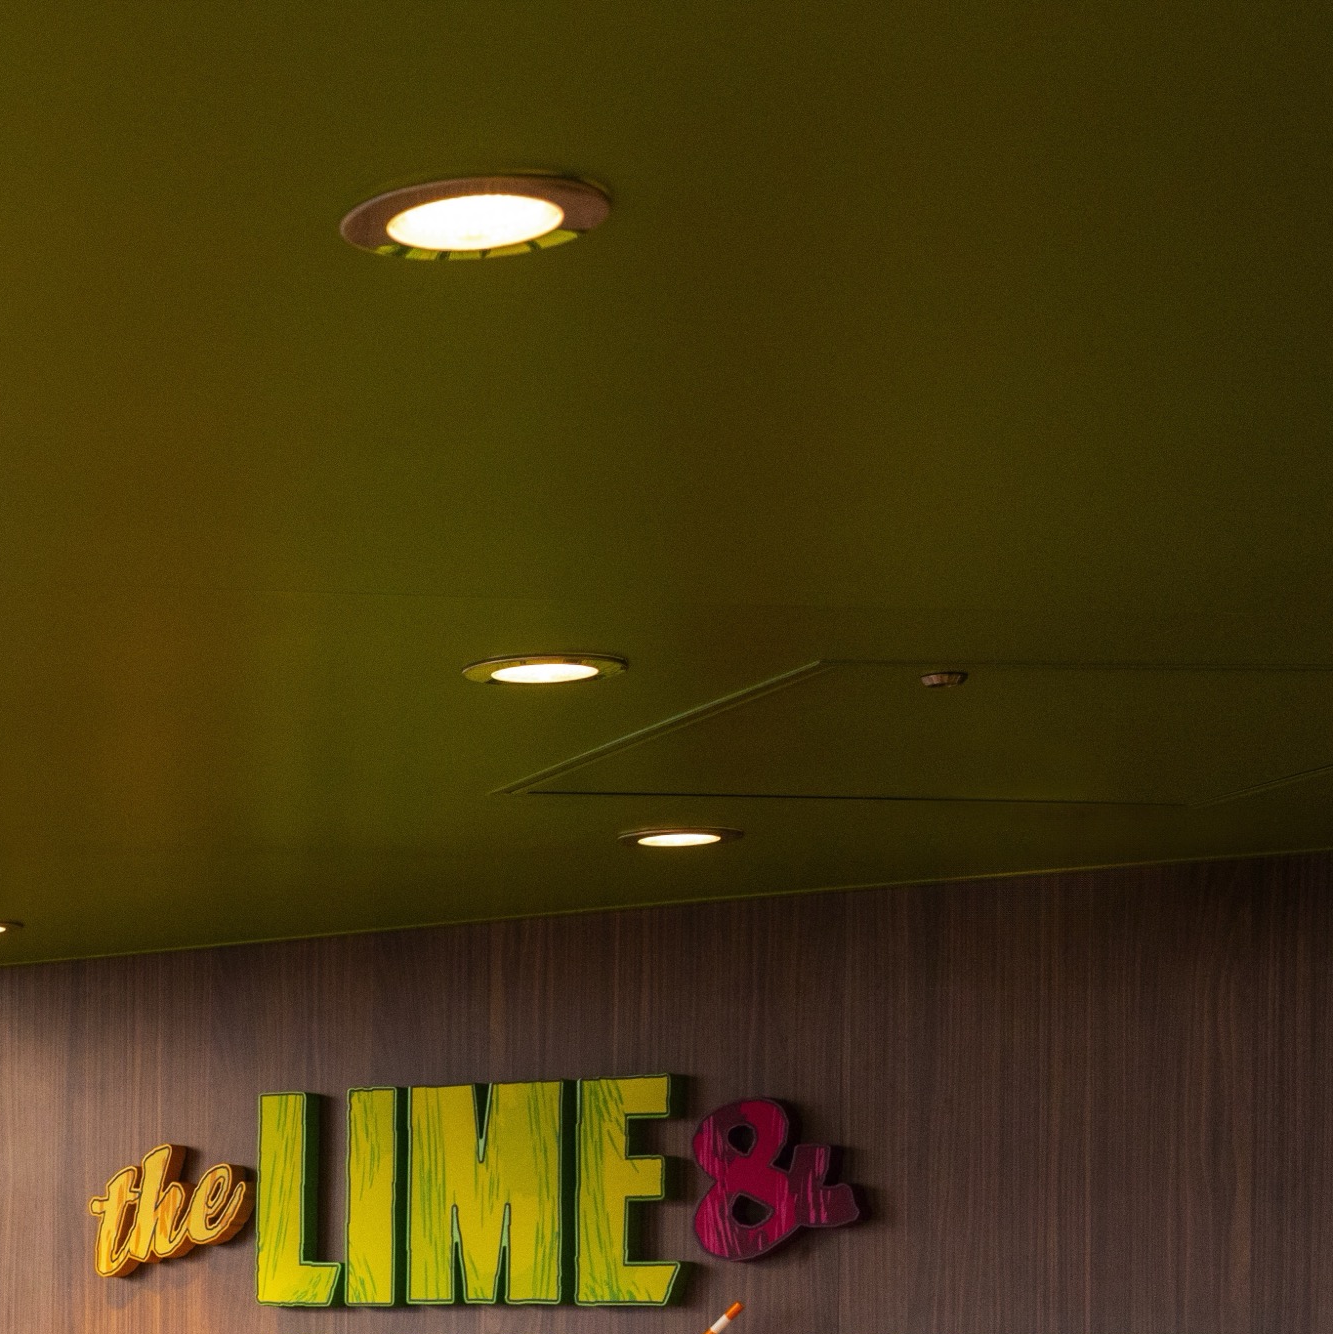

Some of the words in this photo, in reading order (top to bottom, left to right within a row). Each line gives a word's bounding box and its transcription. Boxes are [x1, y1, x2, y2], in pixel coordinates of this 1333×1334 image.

[89, 1143, 251, 1278] the
[255, 1072, 685, 1308] LIME
[691, 1096, 863, 1262] &
